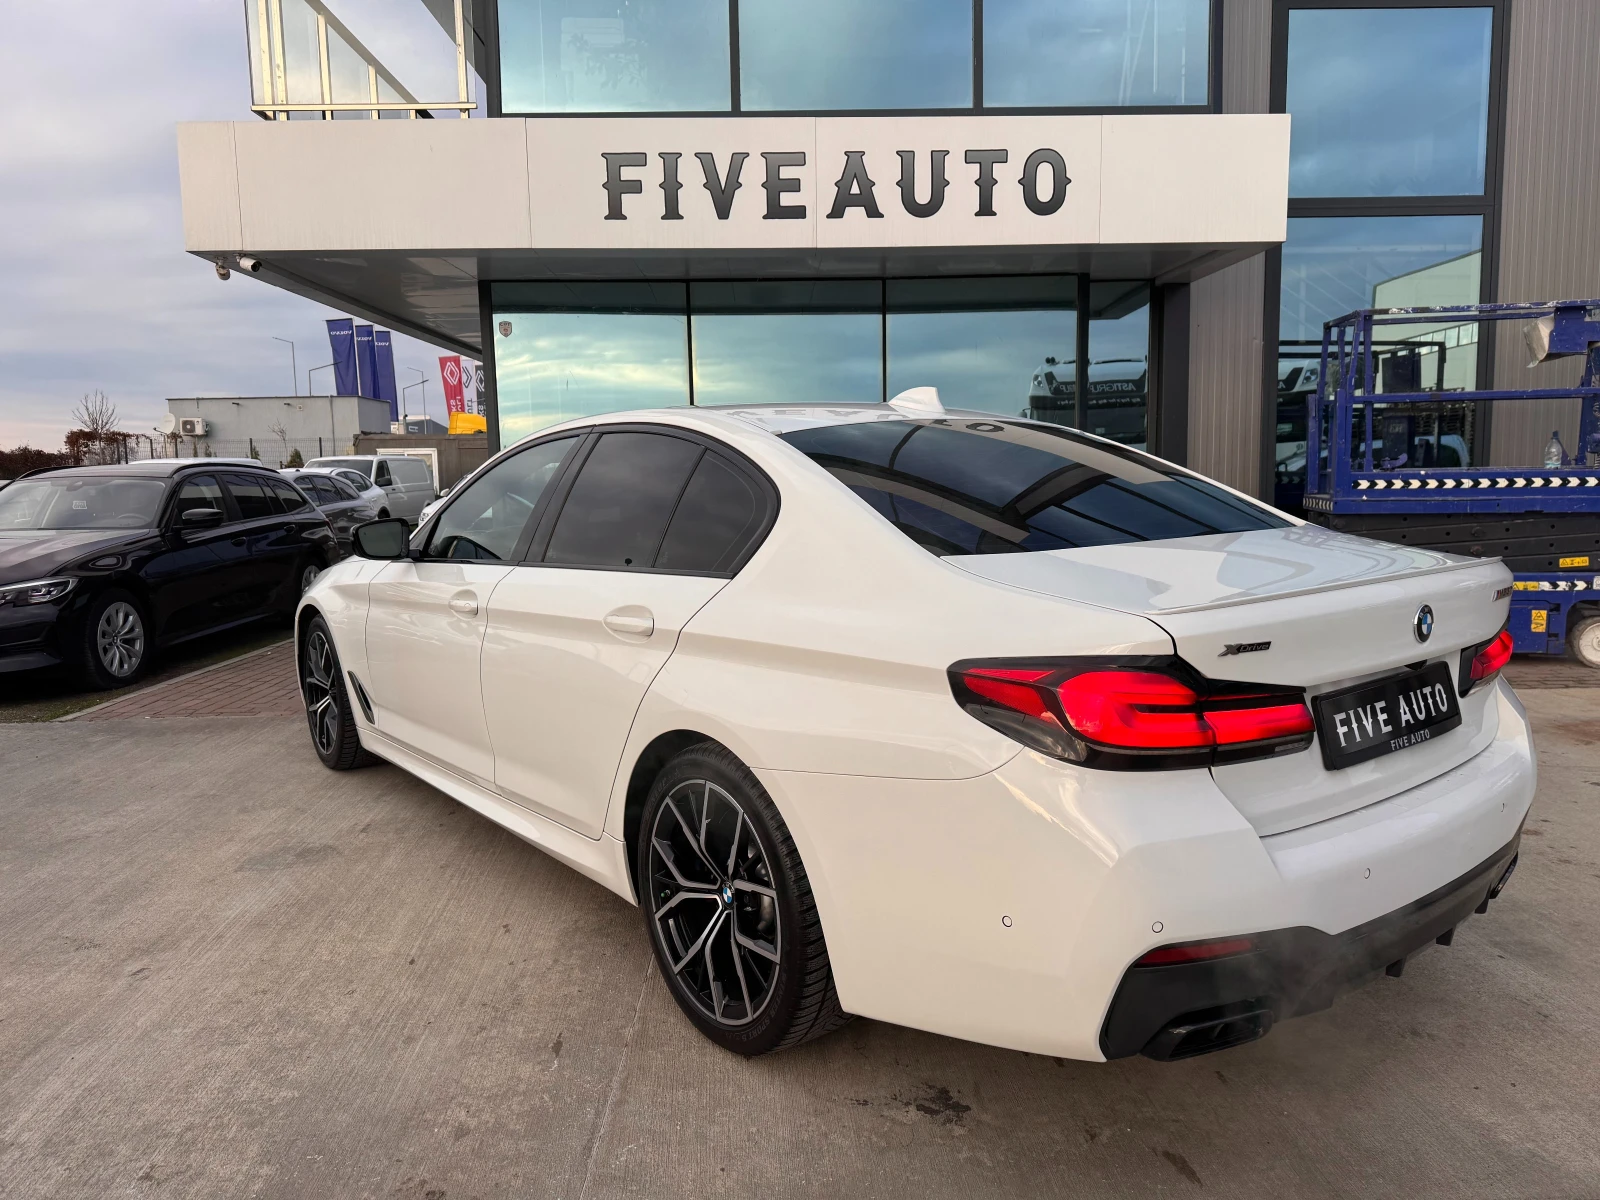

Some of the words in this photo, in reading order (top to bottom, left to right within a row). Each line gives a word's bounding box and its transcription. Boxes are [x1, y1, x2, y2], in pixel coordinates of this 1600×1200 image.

[600, 151, 807, 220] FIVE
[825, 147, 1072, 219] AUTO
[1333, 700, 1393, 748] FIVE
[1397, 682, 1448, 727] AUTO
[1390, 736, 1408, 751] FIVE
[1411, 728, 1431, 745] AUTO
